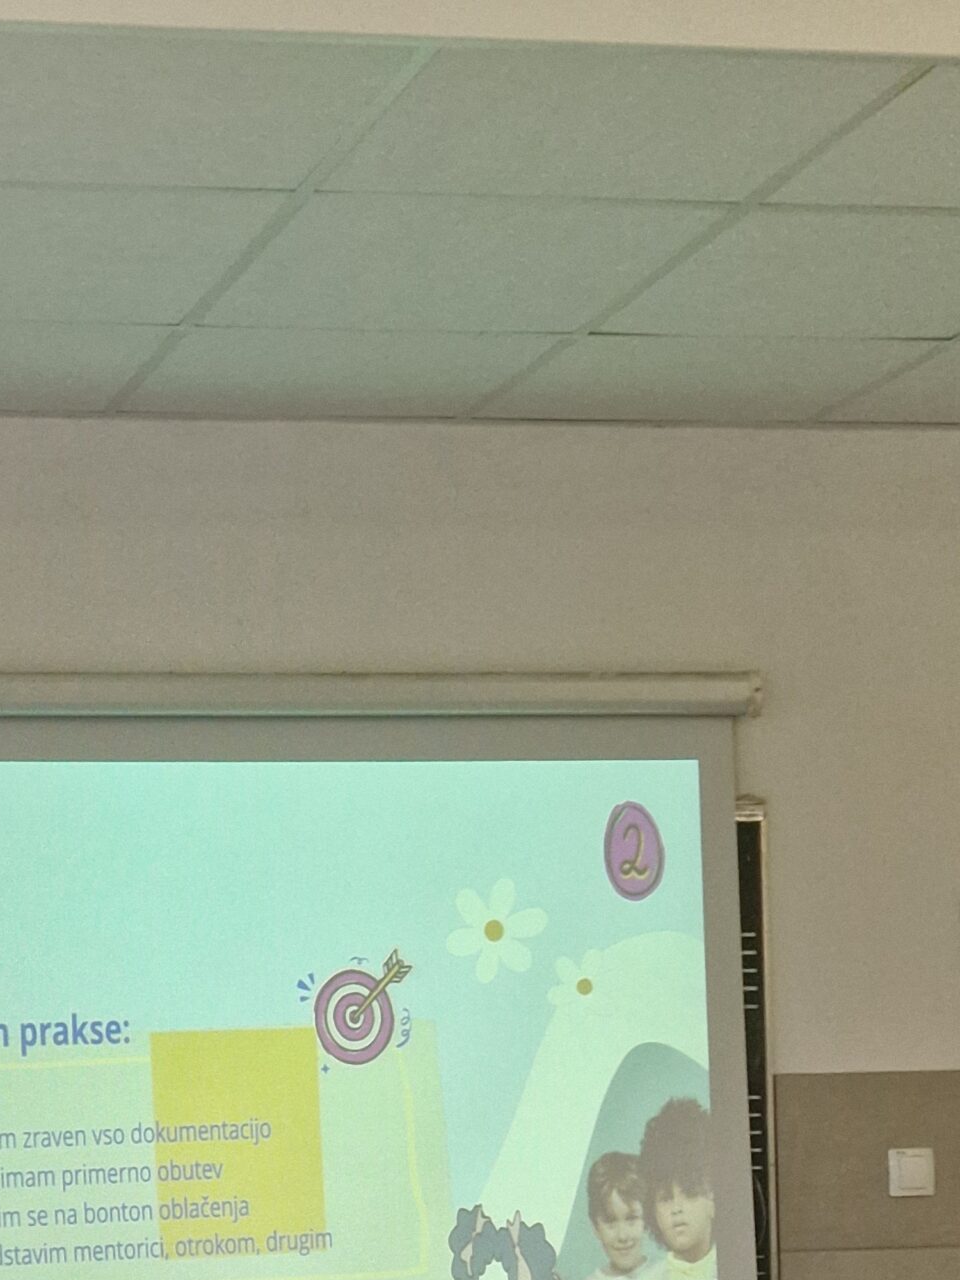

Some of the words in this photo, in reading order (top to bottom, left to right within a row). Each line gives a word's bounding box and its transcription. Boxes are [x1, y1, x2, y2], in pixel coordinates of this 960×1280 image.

[619, 822, 649, 879] 2
[20, 1013, 130, 1056] prakse:
[23, 1128, 87, 1149] zraven
[92, 1126, 125, 1146] vso
[131, 1118, 271, 1145] dokumentacijo
[1, 1166, 55, 1189] imam
[62, 1163, 151, 1191] primerno
[158, 1159, 223, 1181] obutev
[27, 1206, 48, 1227] se
[54, 1206, 78, 1225] na
[84, 1201, 153, 1224] bonton
[158, 1197, 250, 1223] oblačenja
[74, 1237, 169, 1262] mentorici,
[175, 1234, 260, 1258] otrokom,
[266, 1229, 332, 1255] drugim
